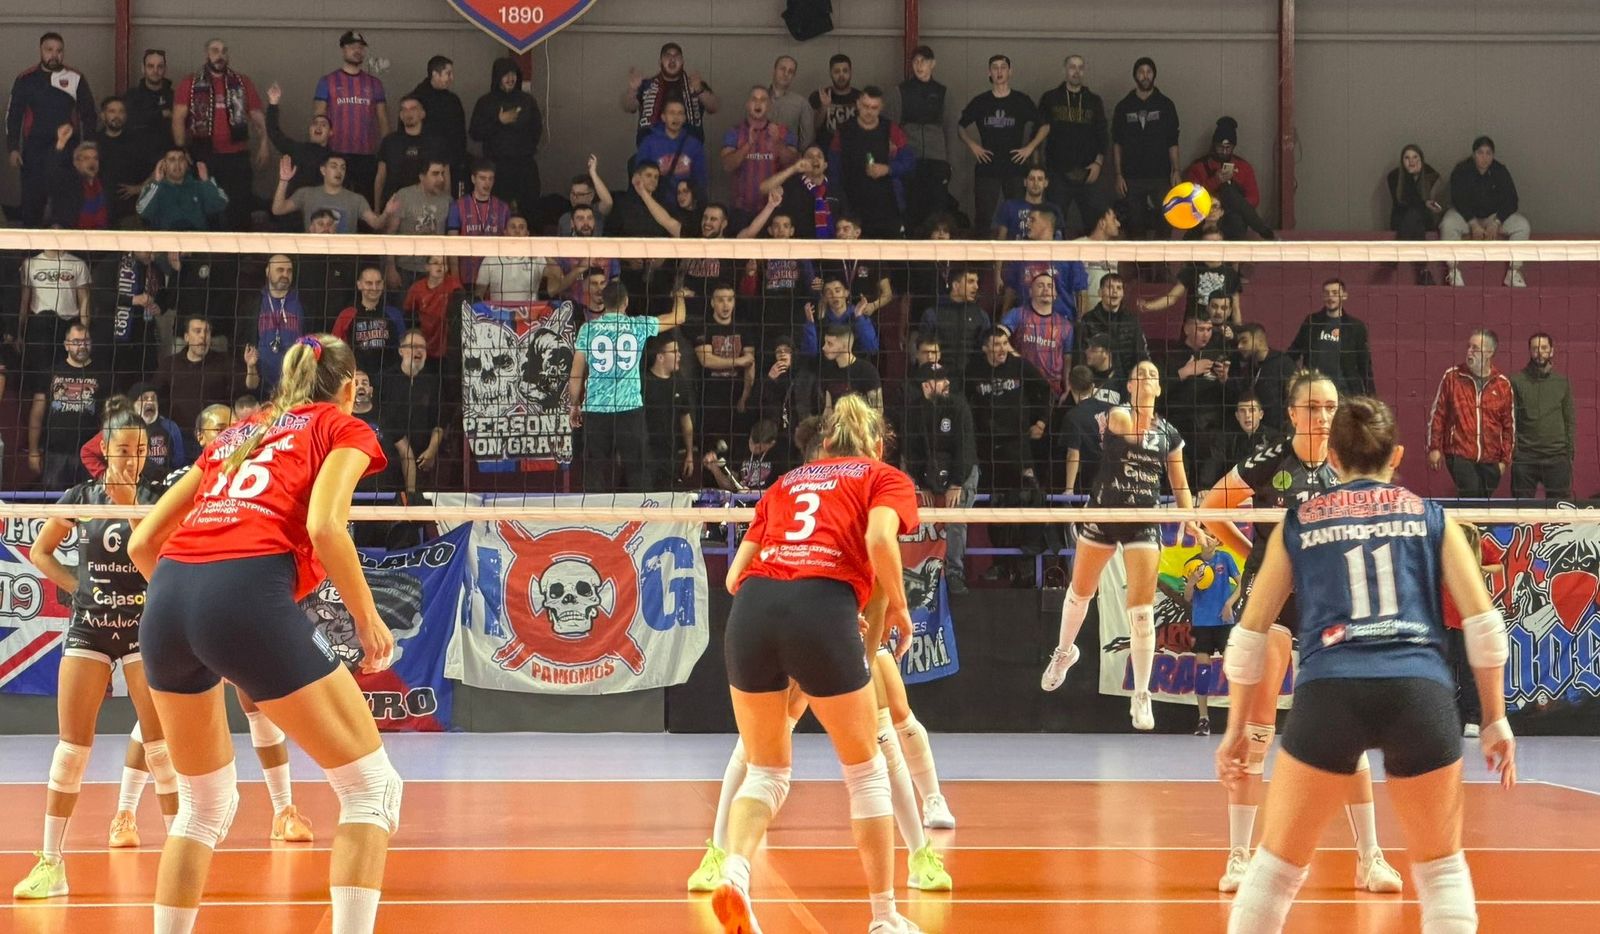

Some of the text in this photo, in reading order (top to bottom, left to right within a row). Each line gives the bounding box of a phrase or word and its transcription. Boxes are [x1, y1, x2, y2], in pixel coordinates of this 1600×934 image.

[498, 5, 544, 24] 1890
[590, 333, 638, 373] 99
[462, 415, 572, 437] PERSONA
[507, 435, 573, 455] GRATA
[204, 447, 273, 499] 16
[789, 479, 839, 496] NOMIKOU
[785, 492, 821, 541] 3
[103, 523, 122, 553] 6
[1299, 519, 1428, 550] XANTHOPOULOU
[640, 536, 696, 631] G
[1343, 542, 1399, 620] 11
[93, 587, 146, 609] Cajasol
[81, 610, 140, 628] Andalucí
